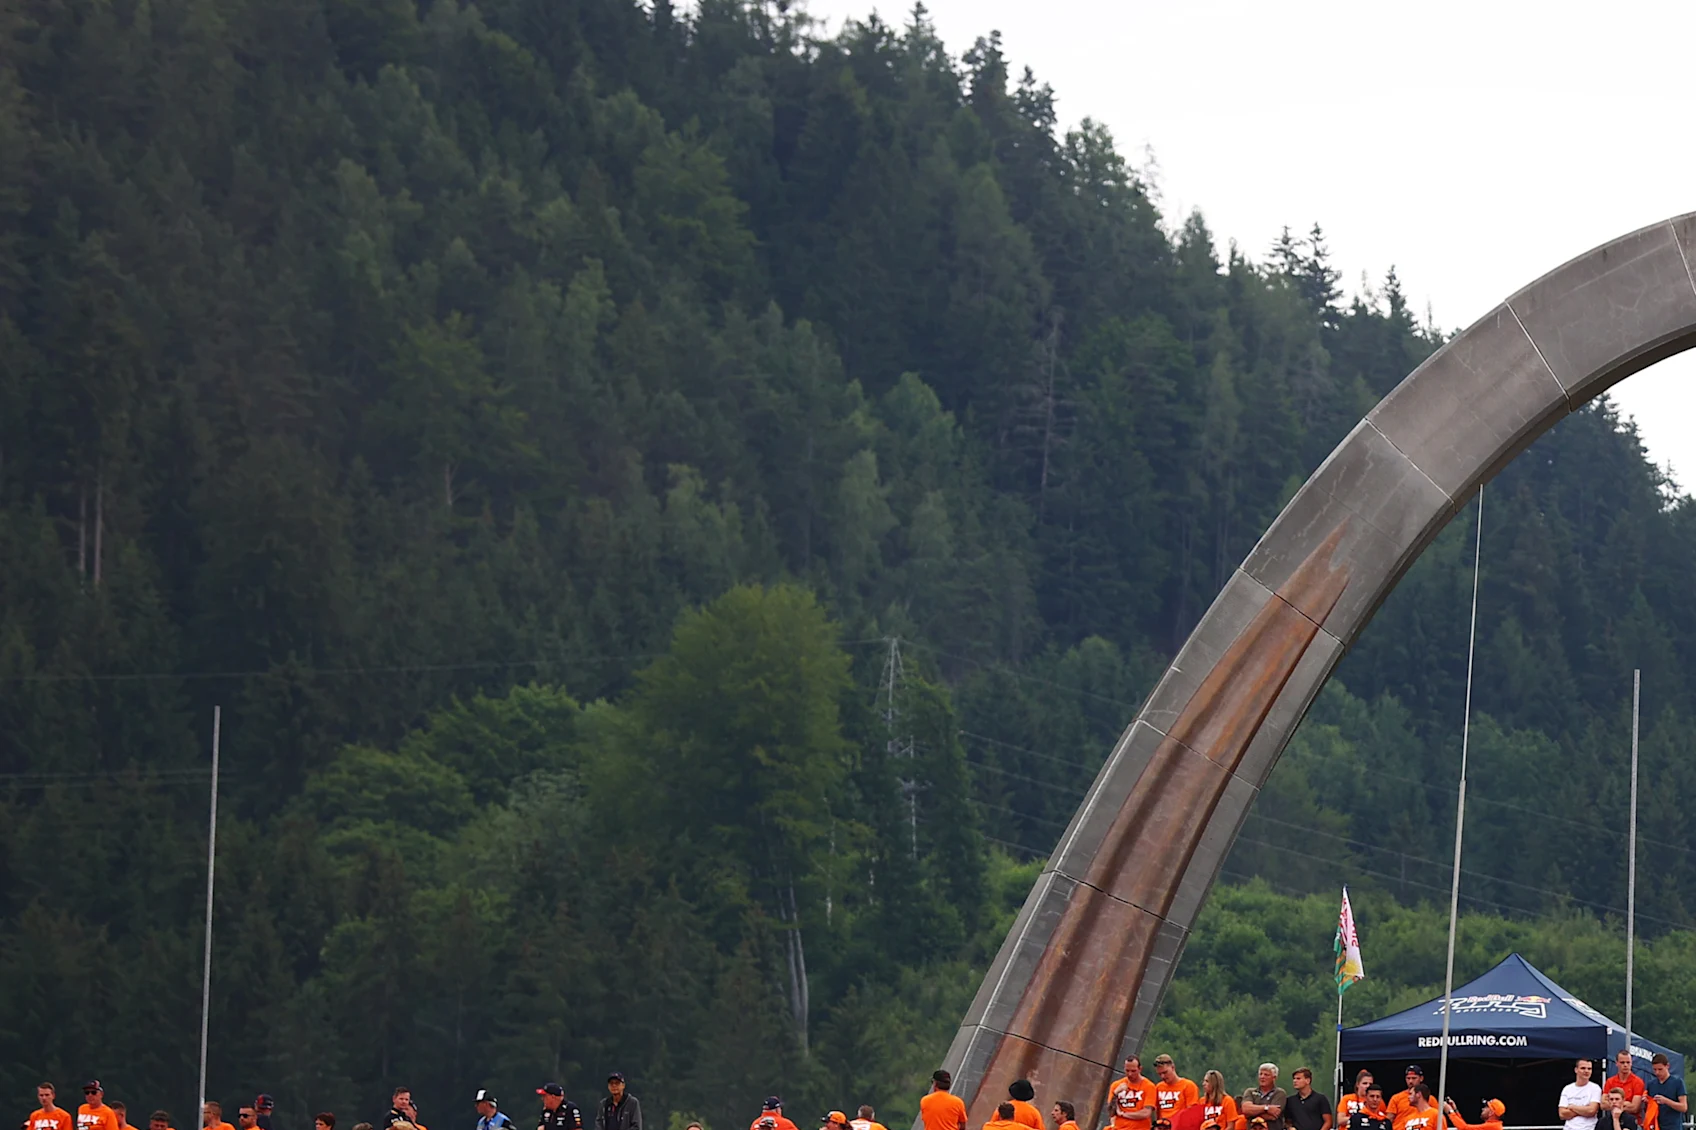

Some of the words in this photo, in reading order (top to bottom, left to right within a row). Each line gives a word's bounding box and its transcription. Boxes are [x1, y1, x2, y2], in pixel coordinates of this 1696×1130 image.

[1418, 1035, 1528, 1048] REDULLRING.COM
[1159, 1092, 1180, 1103] MAX
[78, 1114, 99, 1124] MAX
[1405, 1118, 1428, 1130] MAX
